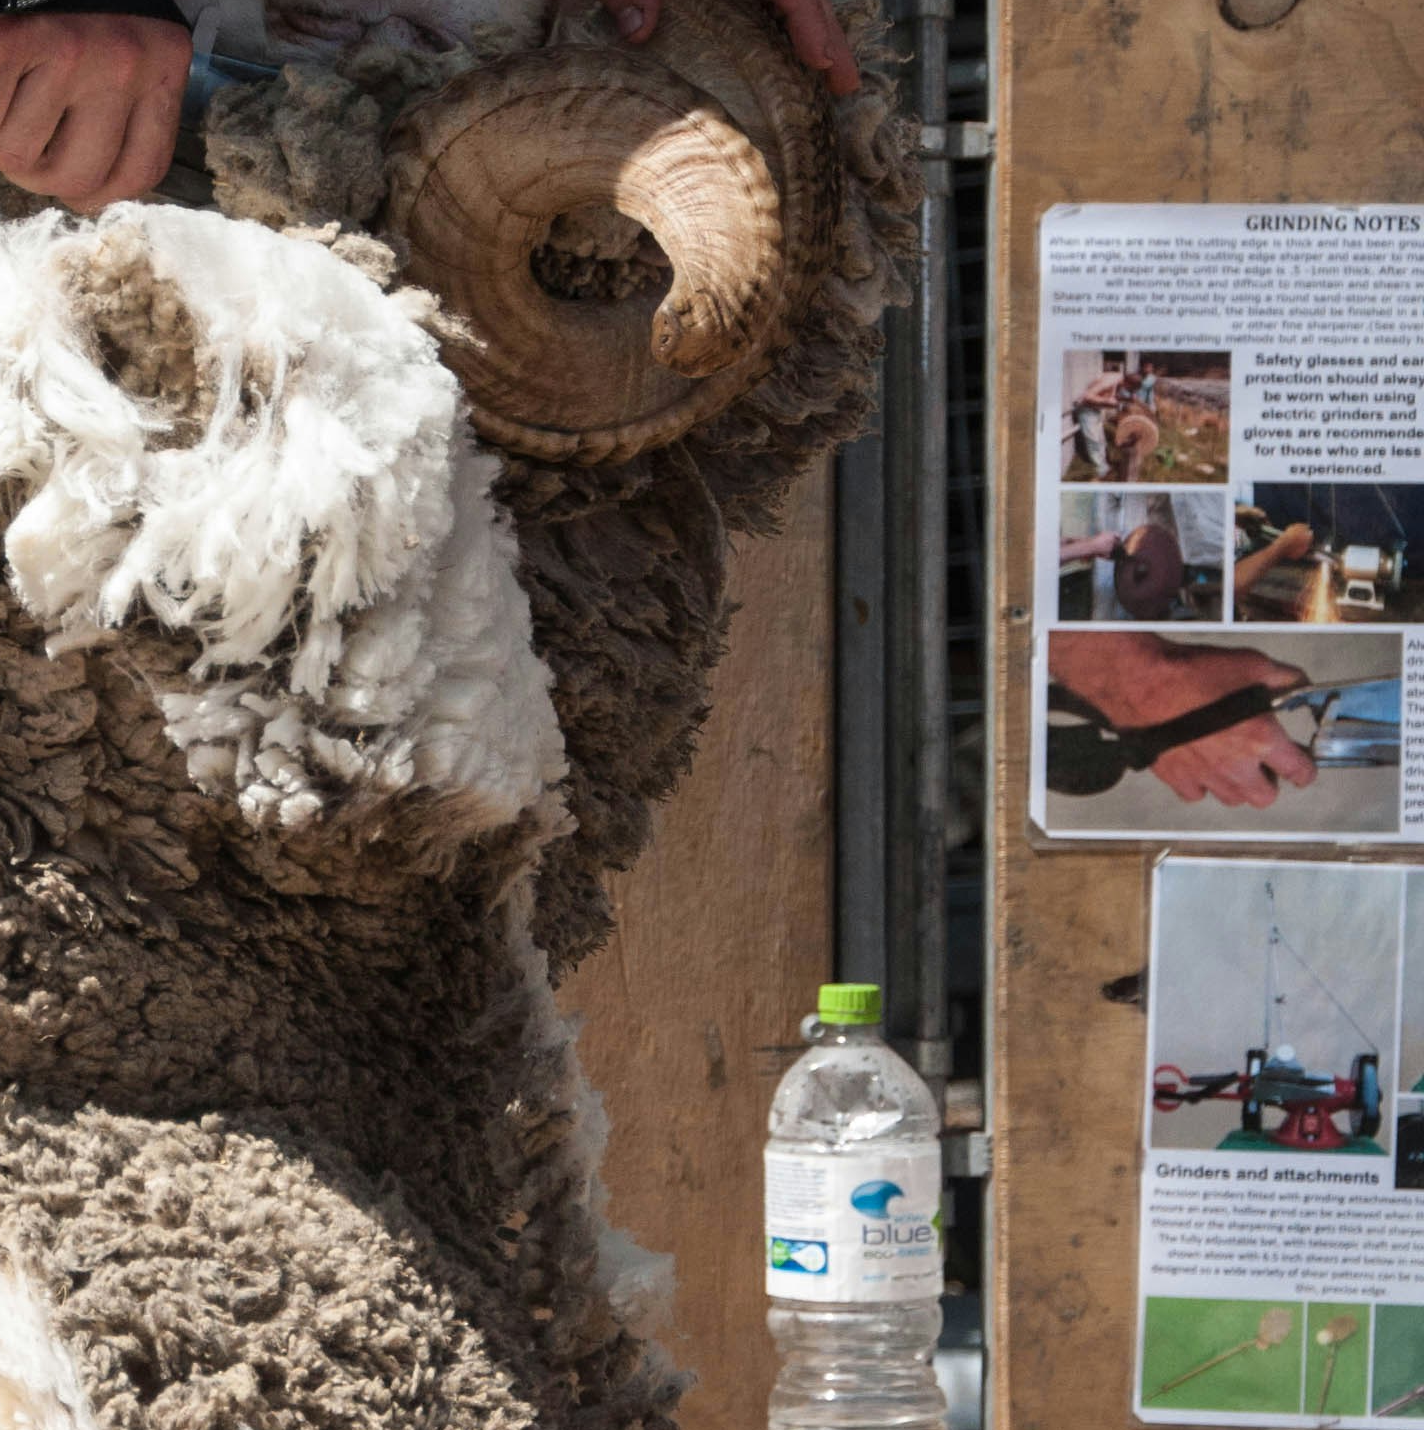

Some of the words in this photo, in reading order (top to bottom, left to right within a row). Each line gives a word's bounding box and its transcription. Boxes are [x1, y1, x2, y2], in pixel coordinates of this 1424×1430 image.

[1246, 214, 1347, 232] GRINDING
[1354, 215, 1421, 232] NOTES
[1148, 239, 1171, 247] new
[1175, 238, 1193, 247] the
[1197, 238, 1237, 249] cutting
[1241, 239, 1269, 249] edge
[1273, 238, 1282, 247] is
[1286, 238, 1312, 248] thick
[1317, 239, 1338, 248] and
[1342, 239, 1362, 248] has
[1366, 239, 1394, 248] been
[1129, 251, 1139, 260] to
[1145, 251, 1175, 260] make
[1180, 251, 1200, 260] this
[1204, 251, 1244, 263] cutting
[1248, 252, 1276, 263] edge
[1279, 252, 1324, 263] sharper
[1327, 252, 1349, 262] and
[1353, 252, 1386, 262] easier
[1391, 253, 1402, 262] to
[1086, 265, 1096, 274] at
[1112, 265, 1154, 276] steeper
[1158, 265, 1189, 276] angle
[1193, 265, 1218, 274] until
[1222, 265, 1241, 274] the
[1245, 266, 1273, 276] edge
[1277, 265, 1285, 275] is
[1377, 266, 1405, 276] After
[1105, 278, 1123, 287] will
[1128, 279, 1171, 288] become
[1177, 279, 1203, 288] thick
[1208, 279, 1228, 288] and
[1233, 279, 1274, 289] difficult
[1278, 280, 1289, 289] to
[1294, 279, 1344, 289] maintain
[1348, 279, 1369, 289] and
[1373, 280, 1411, 289] shears
[1053, 291, 1092, 301] Shears
[1096, 293, 1120, 303] may
[1124, 292, 1147, 301] also
[1151, 292, 1165, 301] be
[1169, 292, 1209, 303] ground
[1213, 292, 1226, 303] by
[1231, 293, 1261, 303] using
[1276, 293, 1310, 303] round
[1381, 295, 1392, 303] or
[1397, 295, 1424, 303] coar
[1052, 306, 1083, 315] these
[1144, 306, 1172, 316] Once
[1225, 306, 1244, 316] the
[1248, 307, 1284, 317] blades
[1288, 307, 1326, 317] should
[1330, 307, 1344, 317] be
[1348, 307, 1393, 317] finished
[1397, 307, 1407, 317] in
[1411, 309, 1418, 317] a
[1247, 321, 1277, 330] other
[1282, 321, 1303, 330] fine
[1071, 332, 1104, 342] There
[1107, 335, 1126, 343] are
[1129, 333, 1171, 343] several
[1175, 333, 1221, 345] grinding
[1225, 333, 1275, 344] methods
[1279, 335, 1296, 344] but
[1301, 335, 1314, 344] all
[1319, 336, 1359, 346] require
[1374, 336, 1411, 346] steady
[1255, 353, 1302, 368] Safety
[1307, 353, 1364, 368] glasses
[1370, 354, 1397, 367] and
[1402, 357, 1424, 367] ear
[1245, 371, 1322, 386] protection
[1327, 373, 1379, 385] should
[1263, 390, 1281, 402] be
[1286, 392, 1323, 402] worn
[1329, 390, 1368, 403] when
[1373, 391, 1416, 405] using
[1261, 408, 1317, 420] electric
[1322, 409, 1384, 423] grinders
[1389, 409, 1416, 421] and
[1244, 426, 1293, 441] gloves
[1298, 429, 1321, 438] are
[1326, 427, 1424, 439] recommende
[1254, 444, 1275, 456] for
[1280, 444, 1322, 457] those
[1327, 444, 1359, 457] who
[1363, 447, 1386, 457] are
[1391, 445, 1421, 457] less
[1290, 463, 1385, 476] experienced.
[1156, 1163, 1231, 1179] Grinders
[1236, 1167, 1268, 1181] and
[1274, 1169, 1380, 1185] attachments
[1304, 1194, 1345, 1205] grinding
[862, 1224, 931, 1245] blue
